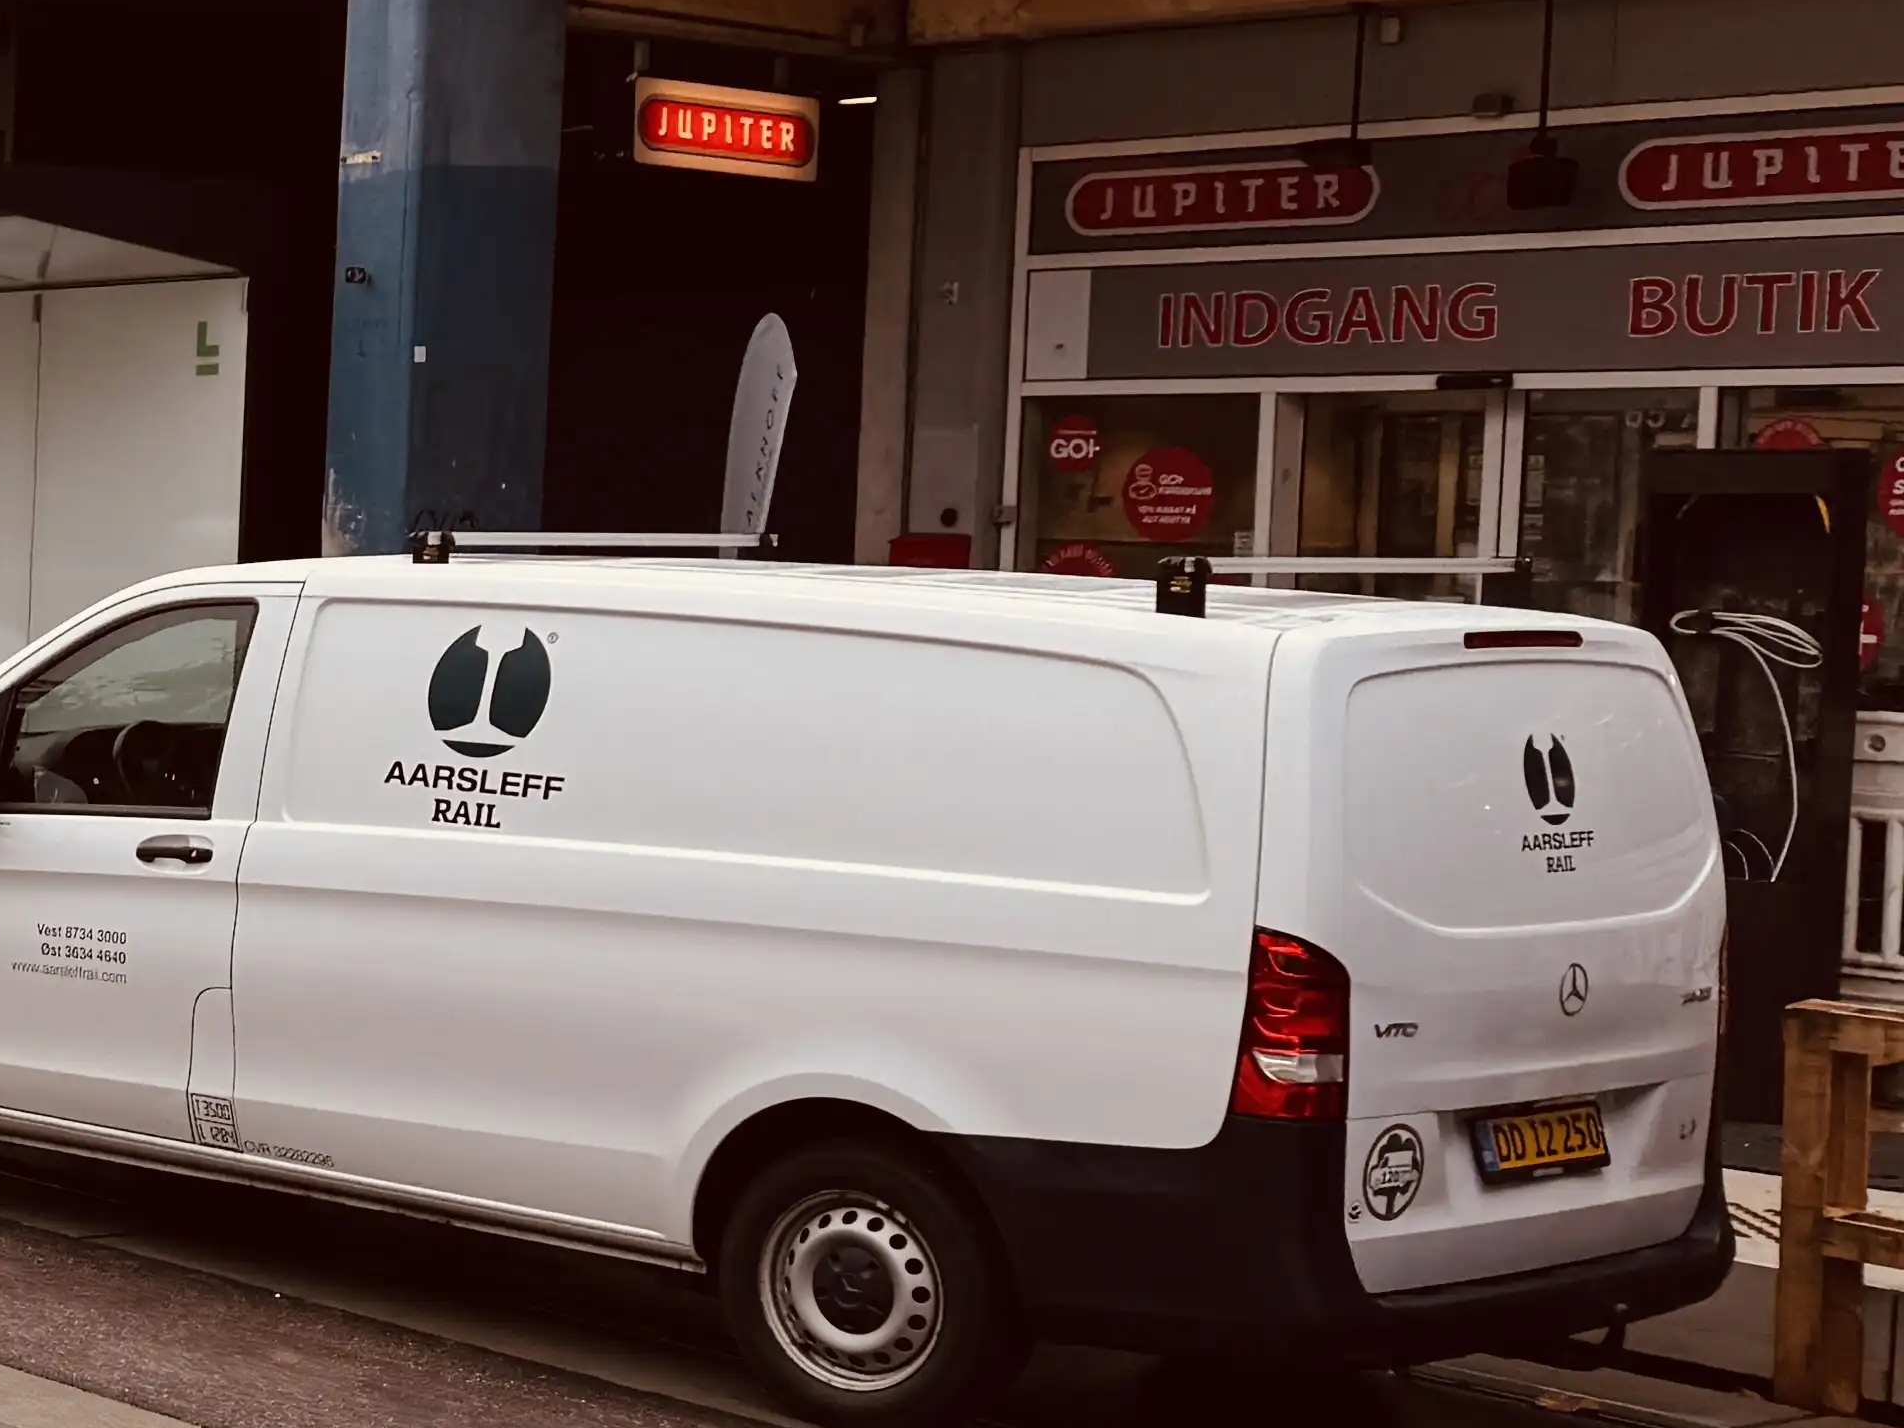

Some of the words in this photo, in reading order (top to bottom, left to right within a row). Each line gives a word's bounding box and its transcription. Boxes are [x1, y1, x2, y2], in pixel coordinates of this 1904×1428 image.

[658, 107, 795, 152] JUPITER
[1100, 174, 1340, 221] JUPITER
[1157, 282, 1498, 349] INDGANG
[1628, 269, 1883, 338] BUTIK
[384, 761, 565, 800] AARSLEFF
[431, 798, 501, 829] RAIL
[1521, 830, 1595, 852] AARSLEFF
[1546, 855, 1577, 873] RAIL
[37, 923, 62, 938] Vest
[65, 926, 93, 941] 8734
[97, 929, 127, 945] 3000
[1374, 1022, 1419, 1039] VITO
[202, 1100, 231, 1121] 3500
[1493, 1121, 1527, 1163] DD
[1533, 1117, 1560, 1158] 12
[1558, 1112, 1601, 1154] 250
